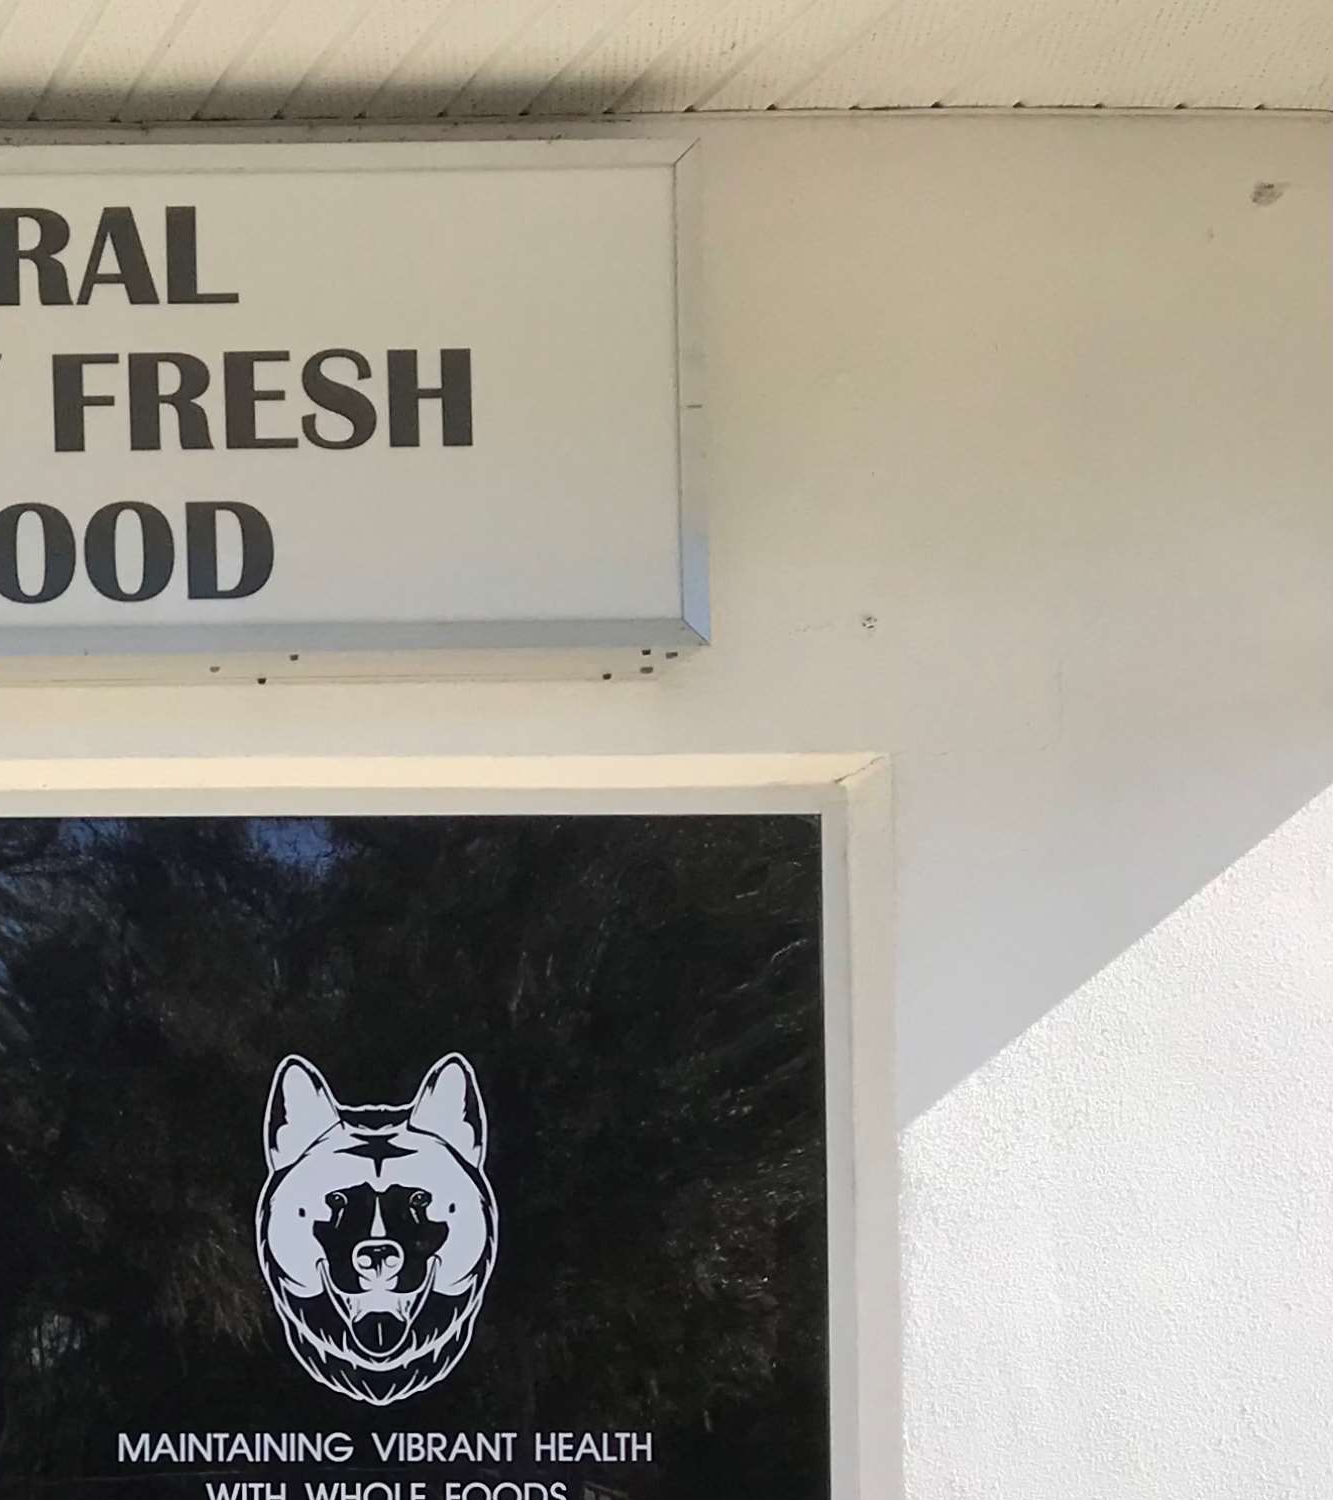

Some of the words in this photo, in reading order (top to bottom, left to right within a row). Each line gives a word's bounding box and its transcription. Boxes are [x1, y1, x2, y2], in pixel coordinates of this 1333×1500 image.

[52, 348, 473, 452] FRESH
[118, 1432, 354, 1462] MAINTAINING
[371, 1432, 518, 1462] VIBRANT
[535, 1432, 652, 1462] HEALTH
